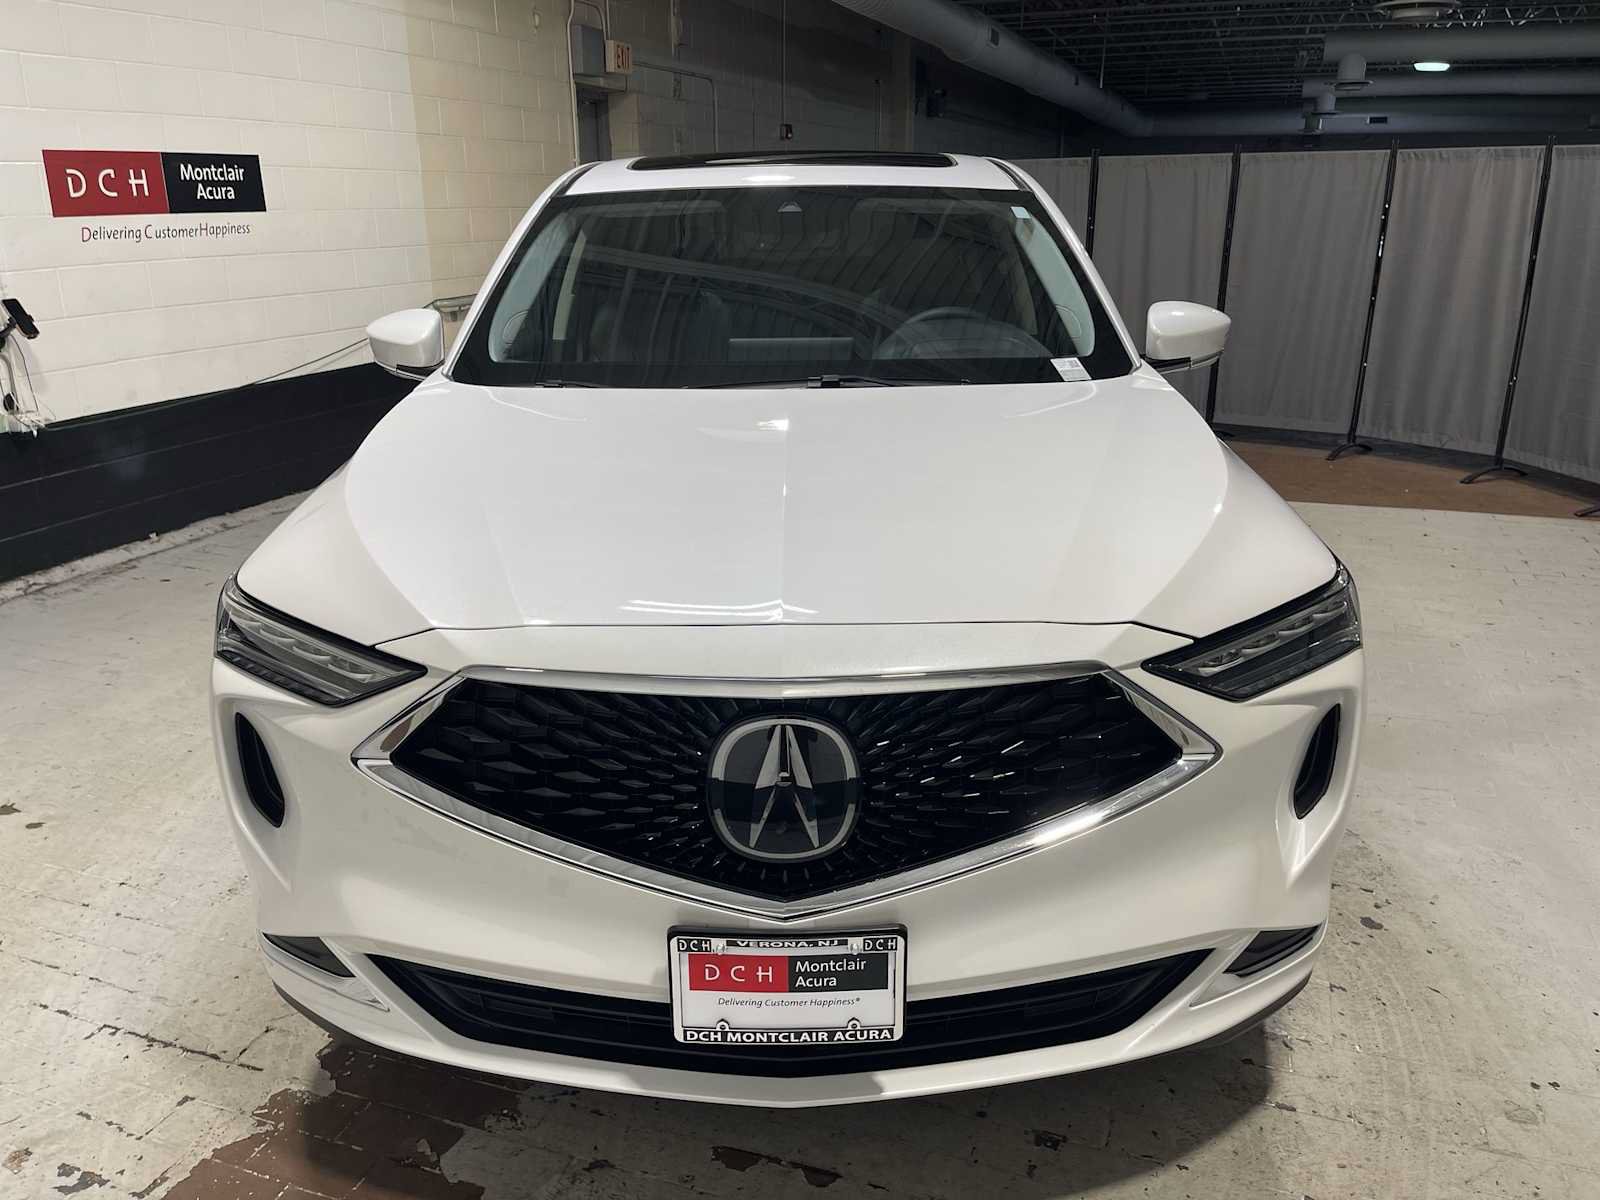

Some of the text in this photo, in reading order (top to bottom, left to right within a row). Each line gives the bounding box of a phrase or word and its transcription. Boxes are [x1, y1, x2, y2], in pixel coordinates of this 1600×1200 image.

[616, 44, 630, 69] EXIT
[179, 163, 245, 182] Montclair
[196, 182, 235, 200] Acura
[80, 222, 251, 243] Delivering Customer Happiness
[678, 939, 711, 952] DCH
[817, 938, 839, 947] NJ
[864, 938, 897, 950] DCH
[795, 958, 866, 973] Montclair
[795, 974, 837, 988] Acura
[718, 997, 762, 1009] Delivering
[764, 998, 808, 1008] Customer
[686, 1029, 892, 1043] DCH MONTCLAIR ACURA
